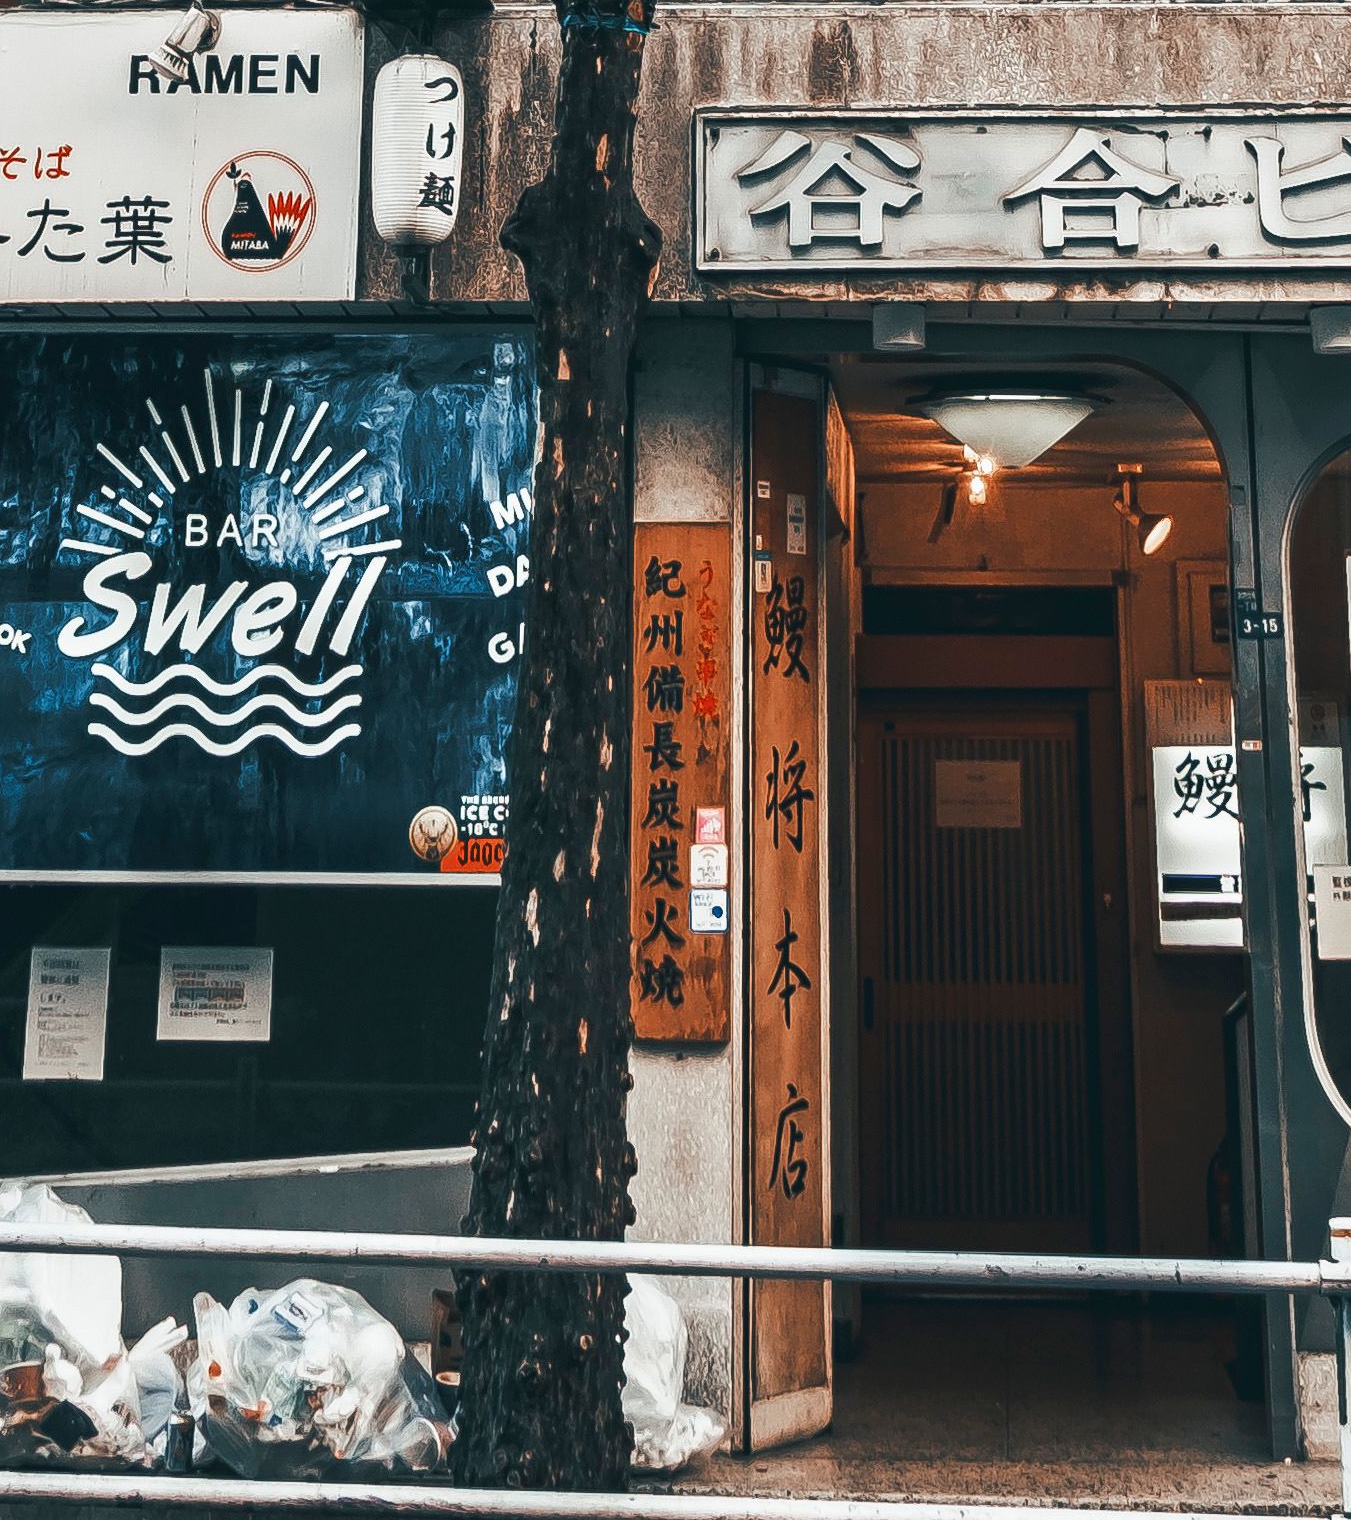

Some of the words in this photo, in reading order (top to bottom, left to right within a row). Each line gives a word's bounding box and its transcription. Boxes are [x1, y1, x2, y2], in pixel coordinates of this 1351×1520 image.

[129, 53, 321, 96] RAMEN
[183, 512, 279, 548] BAR
[58, 553, 387, 659] Swell
[1243, 618, 1278, 633] 3-15
[460, 805, 489, 821] ICE
